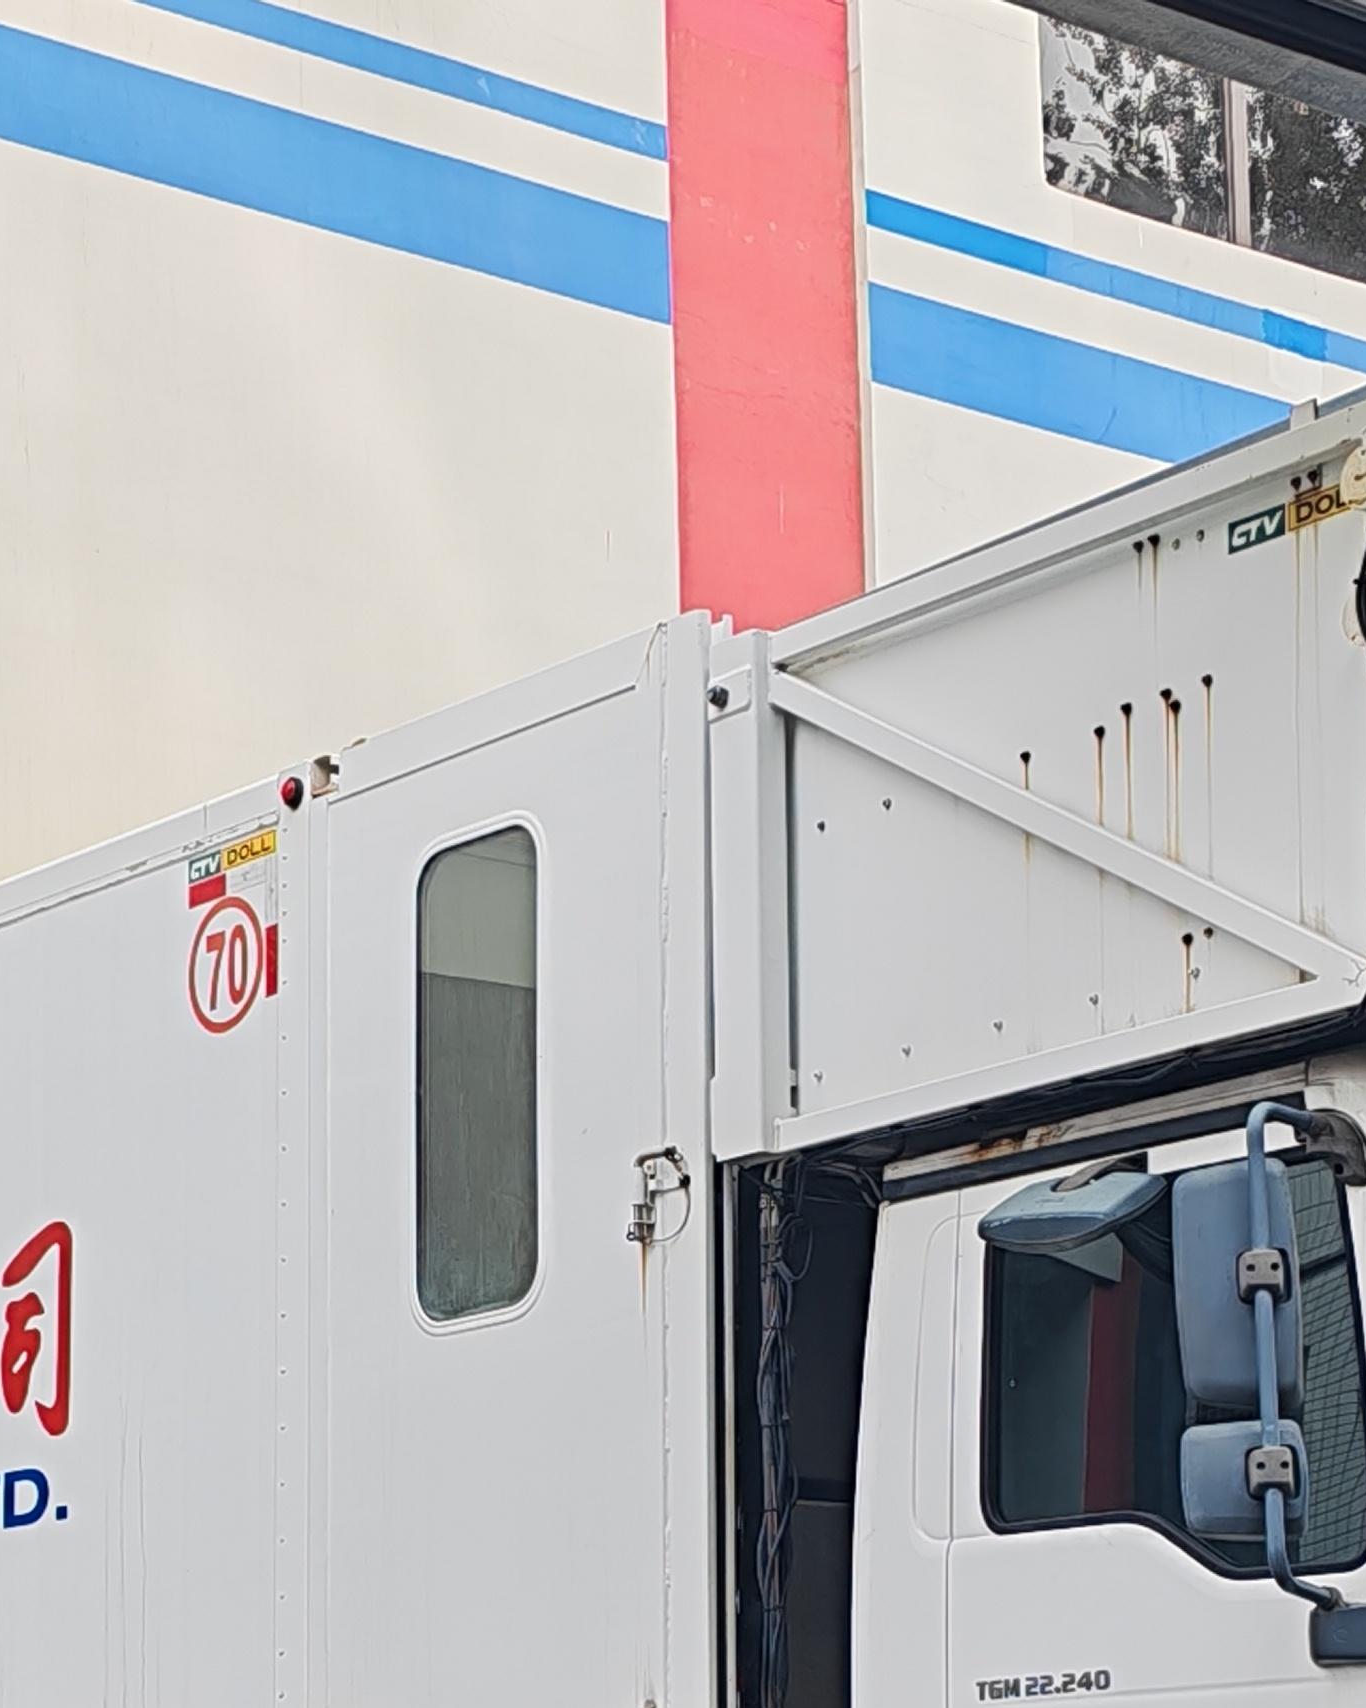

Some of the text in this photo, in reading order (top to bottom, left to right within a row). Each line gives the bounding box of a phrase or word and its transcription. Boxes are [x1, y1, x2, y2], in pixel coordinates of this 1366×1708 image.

[1294, 487, 1351, 523] DOL
[226, 836, 272, 867] DOLL
[206, 923, 248, 1012] 70
[976, 1670, 1111, 1701] TGM 22.240
